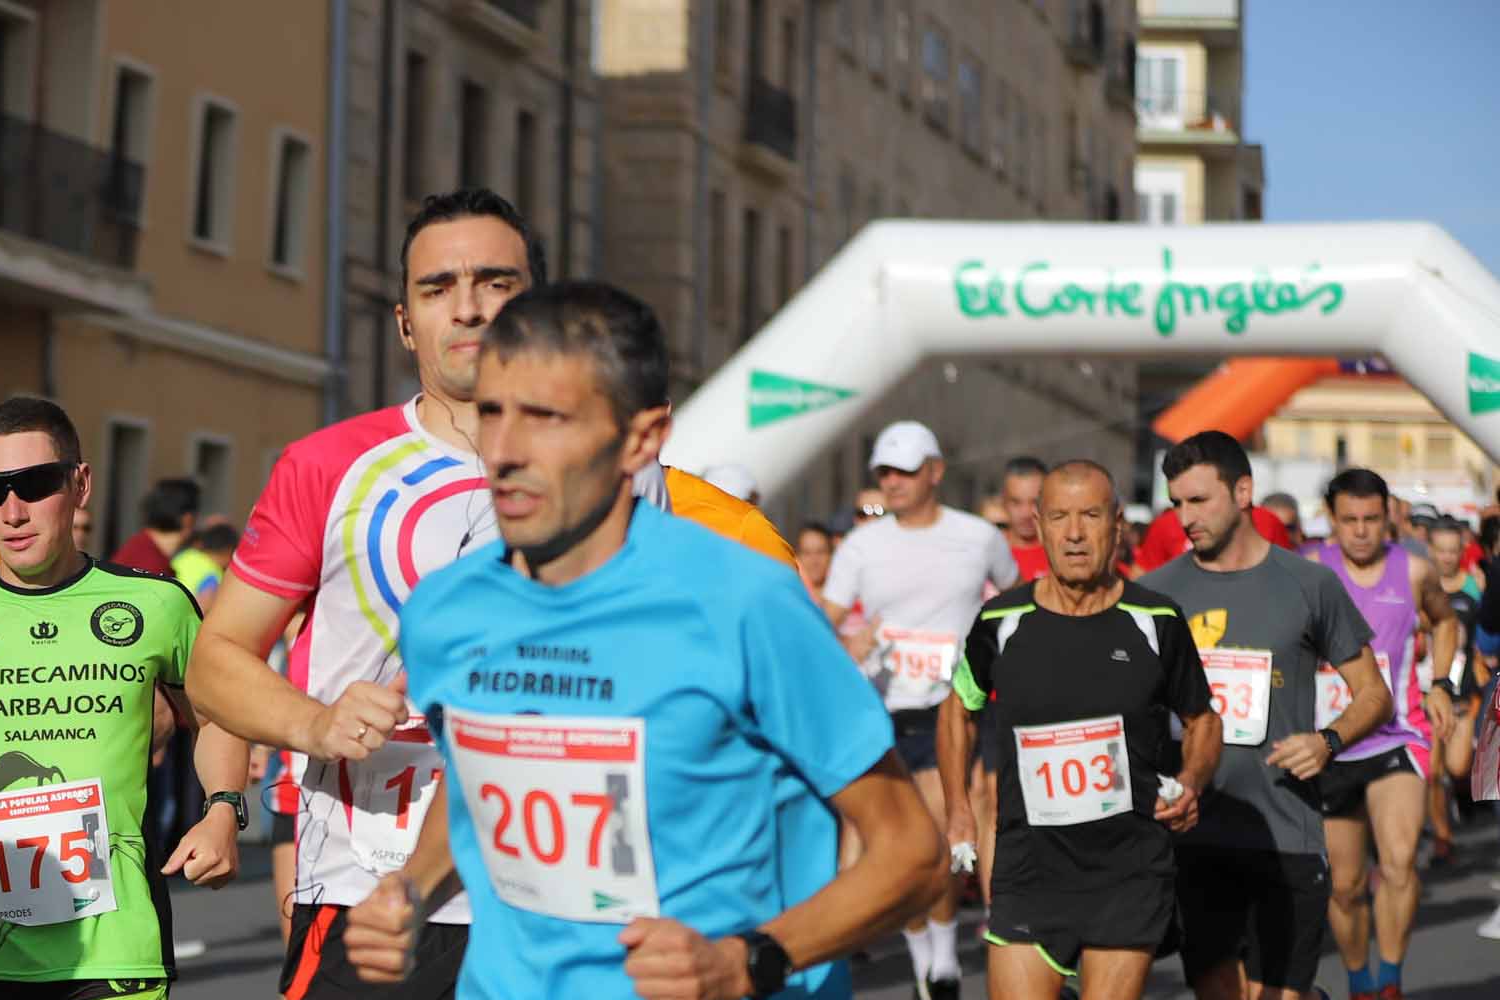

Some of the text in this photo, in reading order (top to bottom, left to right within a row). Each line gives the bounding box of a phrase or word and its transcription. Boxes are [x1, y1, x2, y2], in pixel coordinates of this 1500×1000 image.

[953, 245, 1345, 337] El Corte Inglés
[468, 671, 614, 702] PIEDRAHITA
[4, 727, 97, 742] SALAMANCA
[1036, 755, 1115, 799] 103
[10, 796, 48, 808] POPULAR
[479, 783, 617, 869] 207
